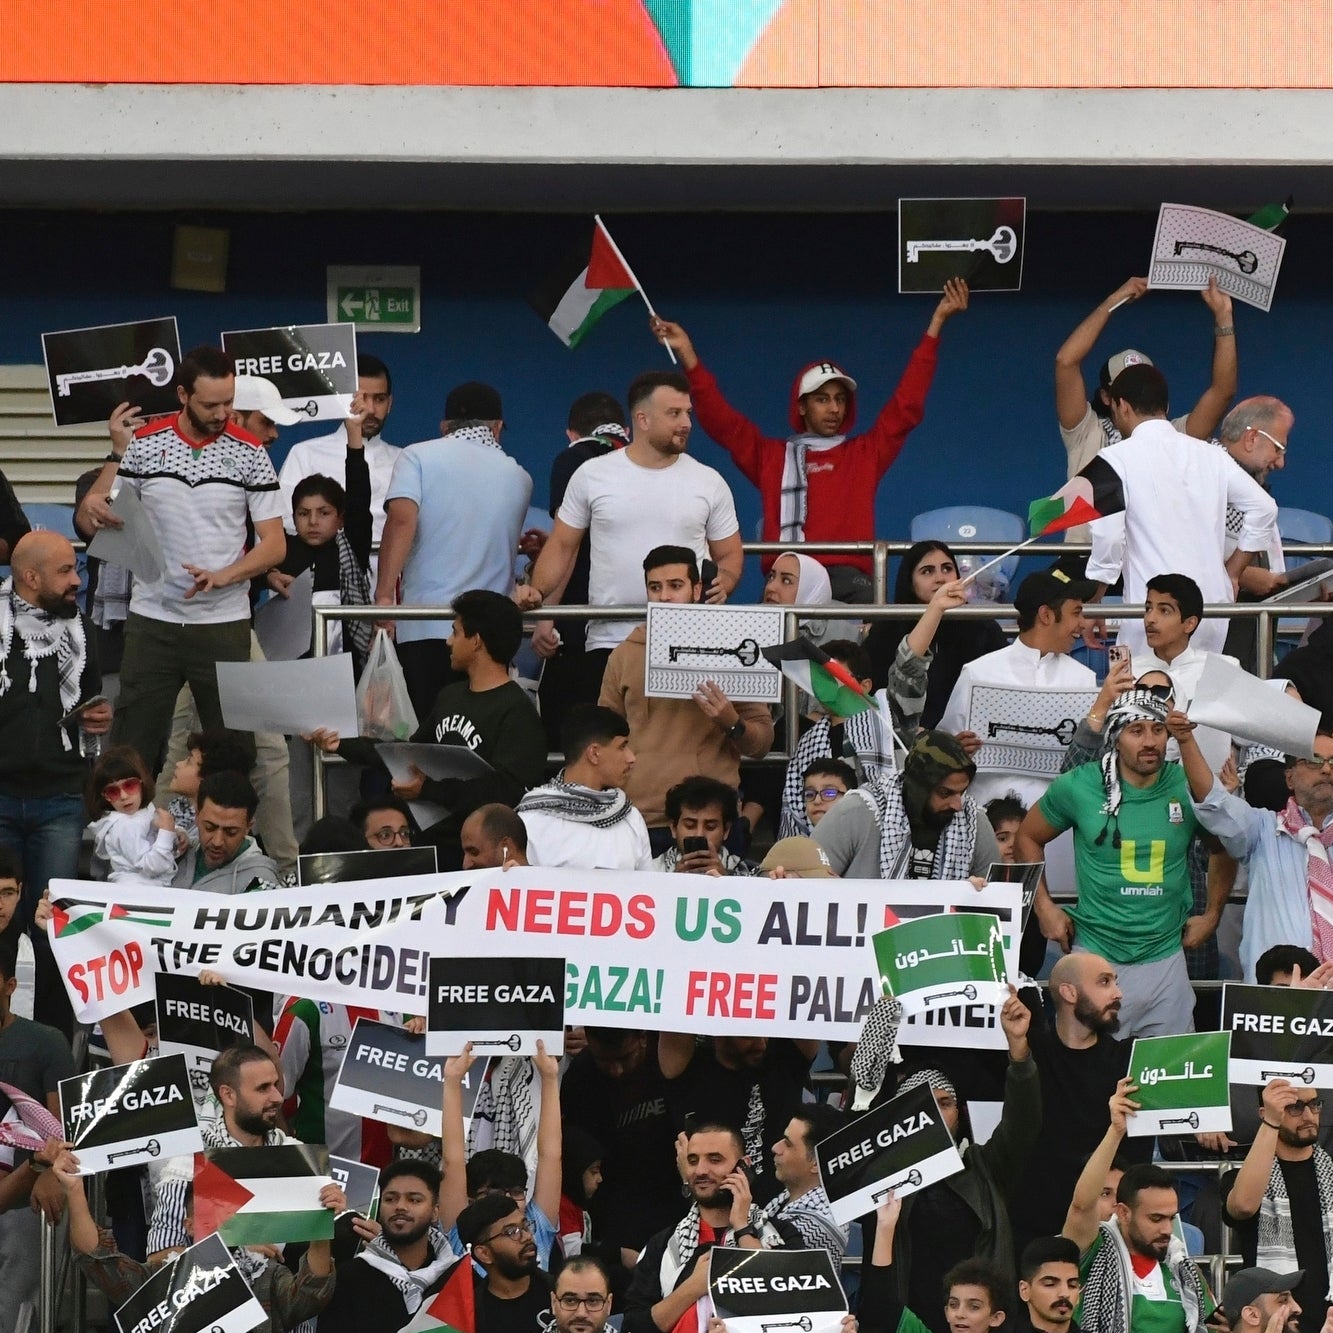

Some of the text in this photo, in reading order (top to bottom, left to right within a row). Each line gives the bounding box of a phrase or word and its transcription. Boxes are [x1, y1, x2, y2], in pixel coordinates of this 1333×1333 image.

[387, 298, 411, 315] Exit
[235, 350, 346, 376] FREE GAZA
[435, 714, 483, 751] DREAMS
[1120, 883, 1163, 896] umniah
[194, 884, 868, 948] HUMANITY NEEDS US ALL!
[893, 938, 988, 971] عائدون
[67, 940, 143, 1004] STOP
[151, 936, 222, 971] THE
[233, 938, 428, 996] GENOCIDE!
[686, 970, 778, 1020] FREE
[437, 984, 555, 1003] FREE GAZA
[165, 999, 251, 1038] FREE GAZA
[1231, 1013, 1285, 1034] FREE
[355, 1043, 470, 1089] FREE GAA
[1139, 1062, 1214, 1086] عائدون
[70, 1083, 184, 1125] FREE GAZA
[827, 1110, 934, 1176] FREE GAZA
[171, 1264, 231, 1310] GAZA
[716, 1272, 831, 1295] FREE GAZA
